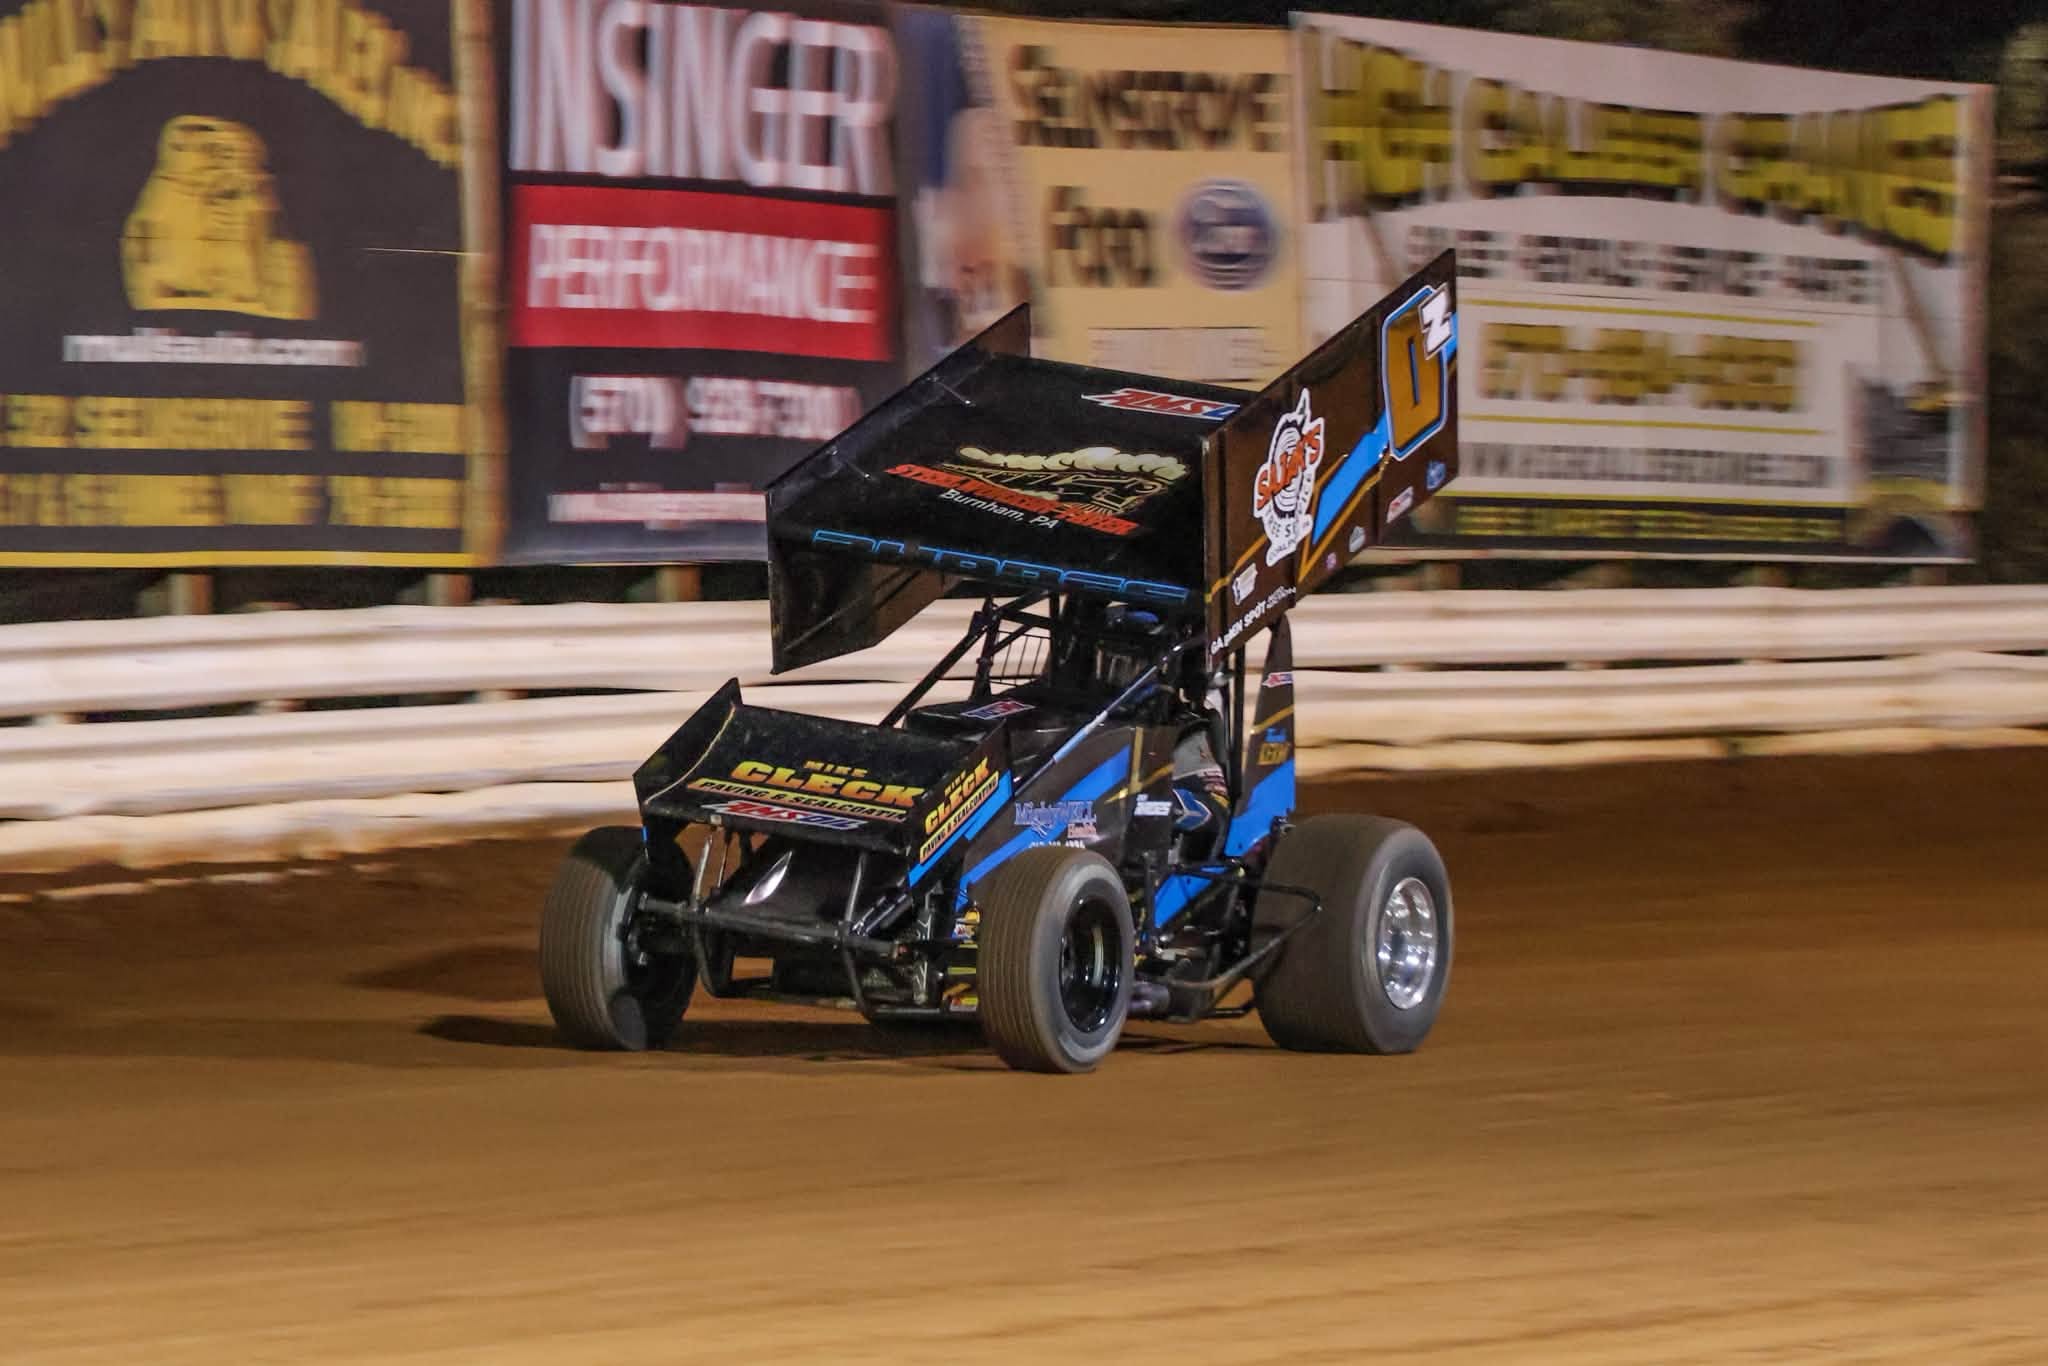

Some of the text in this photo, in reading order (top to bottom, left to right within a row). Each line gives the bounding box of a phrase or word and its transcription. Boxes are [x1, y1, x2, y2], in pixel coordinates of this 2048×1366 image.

[509, 0, 897, 195] INSINGER
[527, 224, 880, 324] PERFORMANCE
[940, 488, 1060, 529] Burnham, PA
[699, 781, 769, 797] PAVING
[731, 761, 925, 808] CLECK
[925, 757, 989, 834] CLECK
